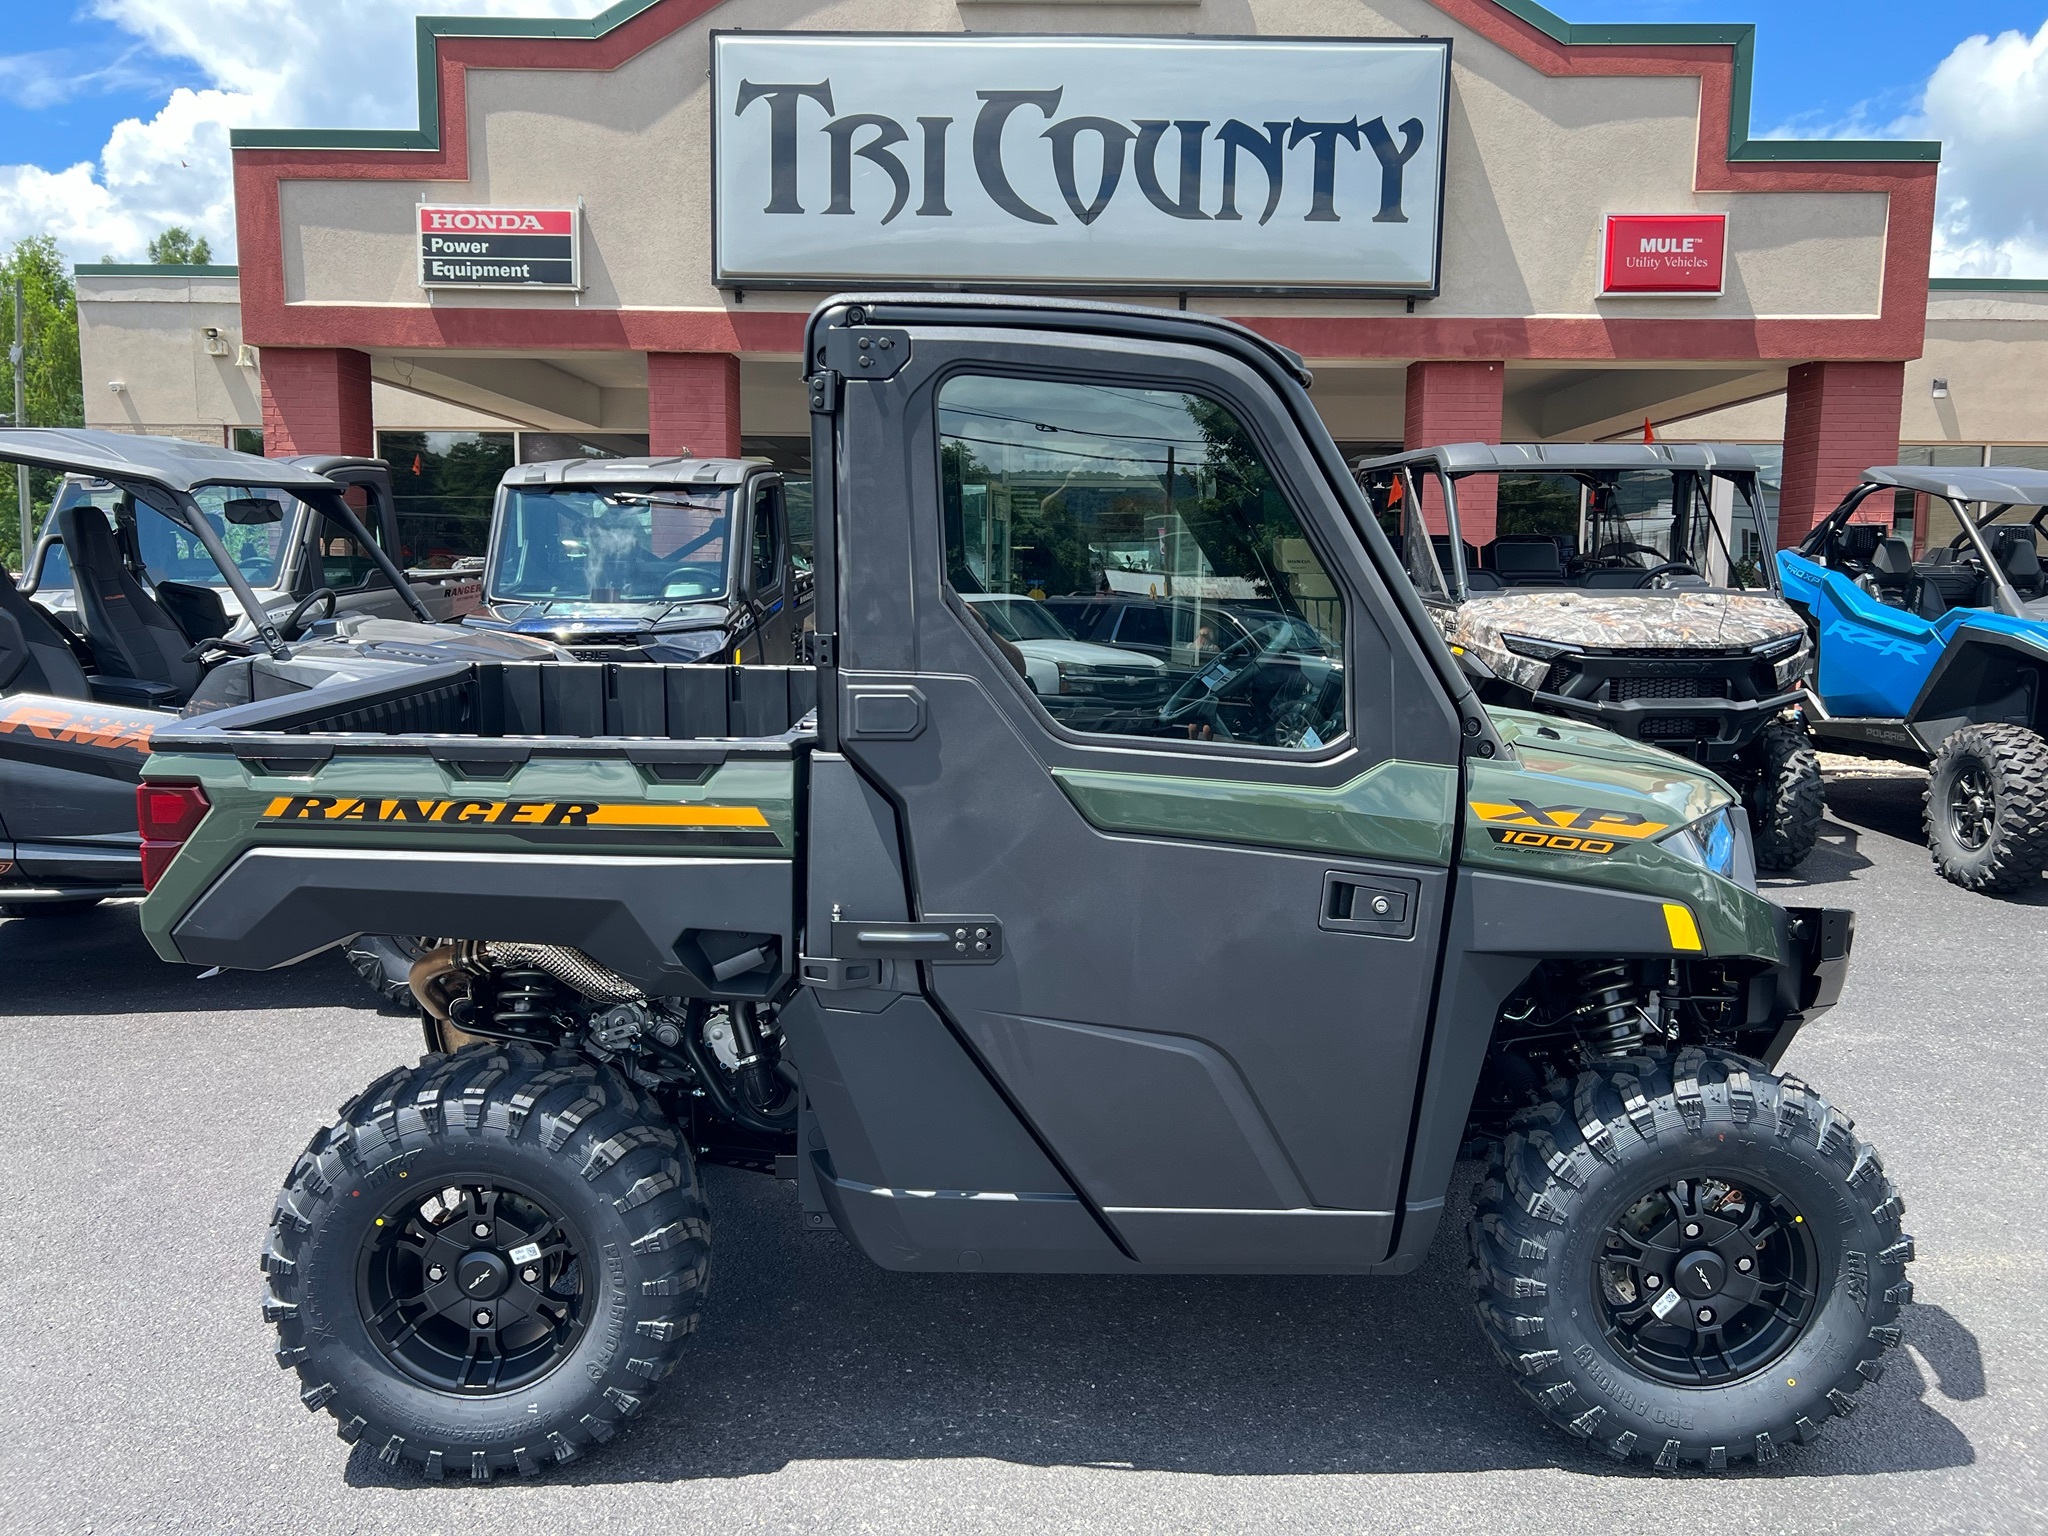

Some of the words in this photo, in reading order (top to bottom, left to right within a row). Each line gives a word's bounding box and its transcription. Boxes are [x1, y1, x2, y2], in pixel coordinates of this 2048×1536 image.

[430, 213, 544, 230] HONDA
[431, 238, 489, 254] Power
[432, 261, 530, 279] Equipment
[1626, 256, 1661, 270] Utility
[1664, 257, 1708, 268] Vehicles
[1787, 564, 1803, 578] PRO
[1804, 573, 1821, 584] XP
[444, 583, 482, 598] RANGER
[733, 612, 751, 635] XP
[1823, 619, 1928, 666] RZR
[572, 650, 610, 660] ARIS
[0, 706, 155, 754] RMA
[1866, 728, 1907, 742] POLARIS
[278, 795, 600, 826] RANGER
[1487, 798, 1648, 830] XP
[1501, 830, 1614, 854] 1000
[1493, 846, 1521, 854] DUAL
[1523, 848, 1577, 860] OVERHEAD
[468, 1268, 491, 1290] XP
[1695, 1266, 1712, 1291] XP
